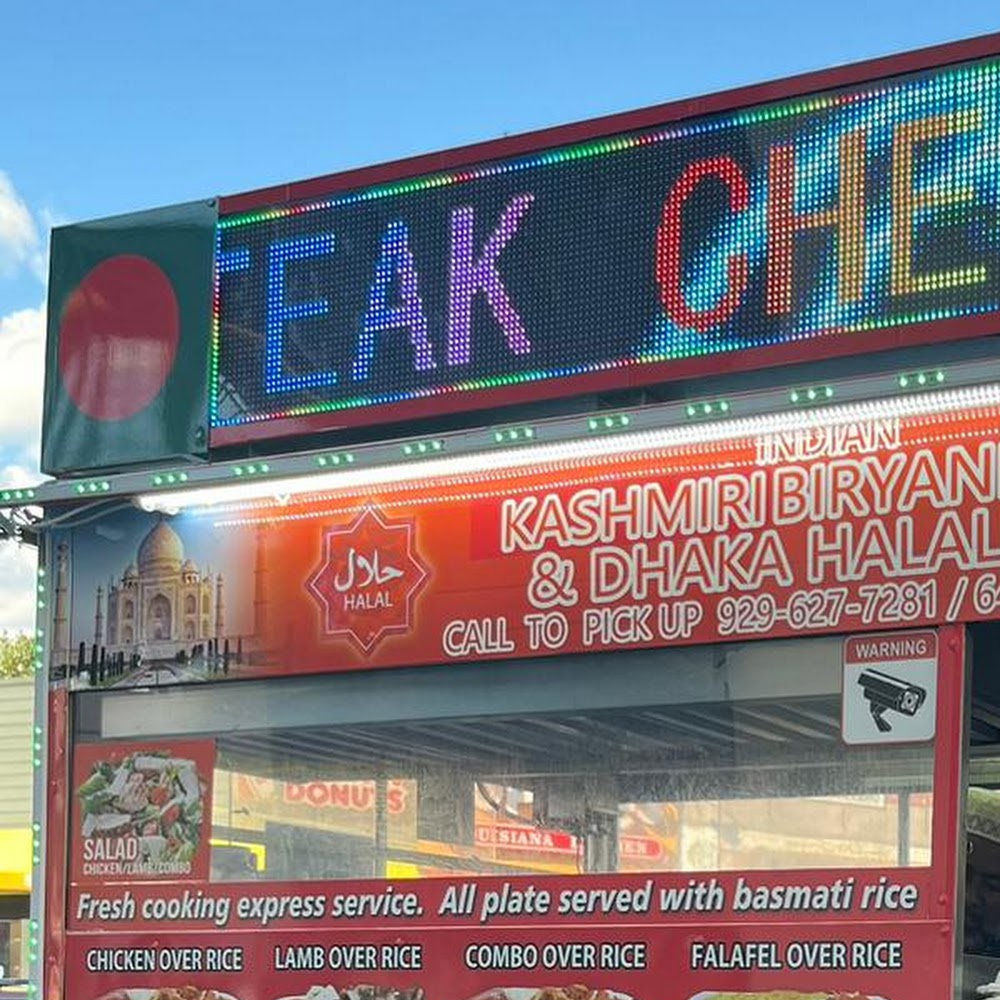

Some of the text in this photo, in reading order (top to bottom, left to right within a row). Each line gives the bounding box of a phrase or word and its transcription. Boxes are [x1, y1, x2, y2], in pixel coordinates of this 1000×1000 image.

[756, 418, 901, 465] INDIAN
[501, 471, 767, 553] KASHMIRI
[334, 548, 404, 591] حلال
[528, 551, 579, 606] &
[590, 529, 794, 603] DHAKA
[344, 590, 394, 611] HALAL
[443, 617, 515, 656] CALL
[525, 612, 568, 650] TO
[583, 609, 656, 645] PICK
[658, 603, 702, 638] UP
[718, 577, 936, 635] 929-627-7281
[945, 576, 969, 621] /
[856, 639, 927, 658] WARNING
[83, 837, 138, 861] SALAD
[77, 877, 918, 928] Fresh cooking express service. All plate served with basmati rice
[86, 947, 243, 971] CHICKEN OVER RICE
[275, 945, 422, 970] LAMB OVER RICE
[465, 944, 645, 968] COMBO OVER RICE
[691, 942, 901, 968] FALAFEL OVER RICE
